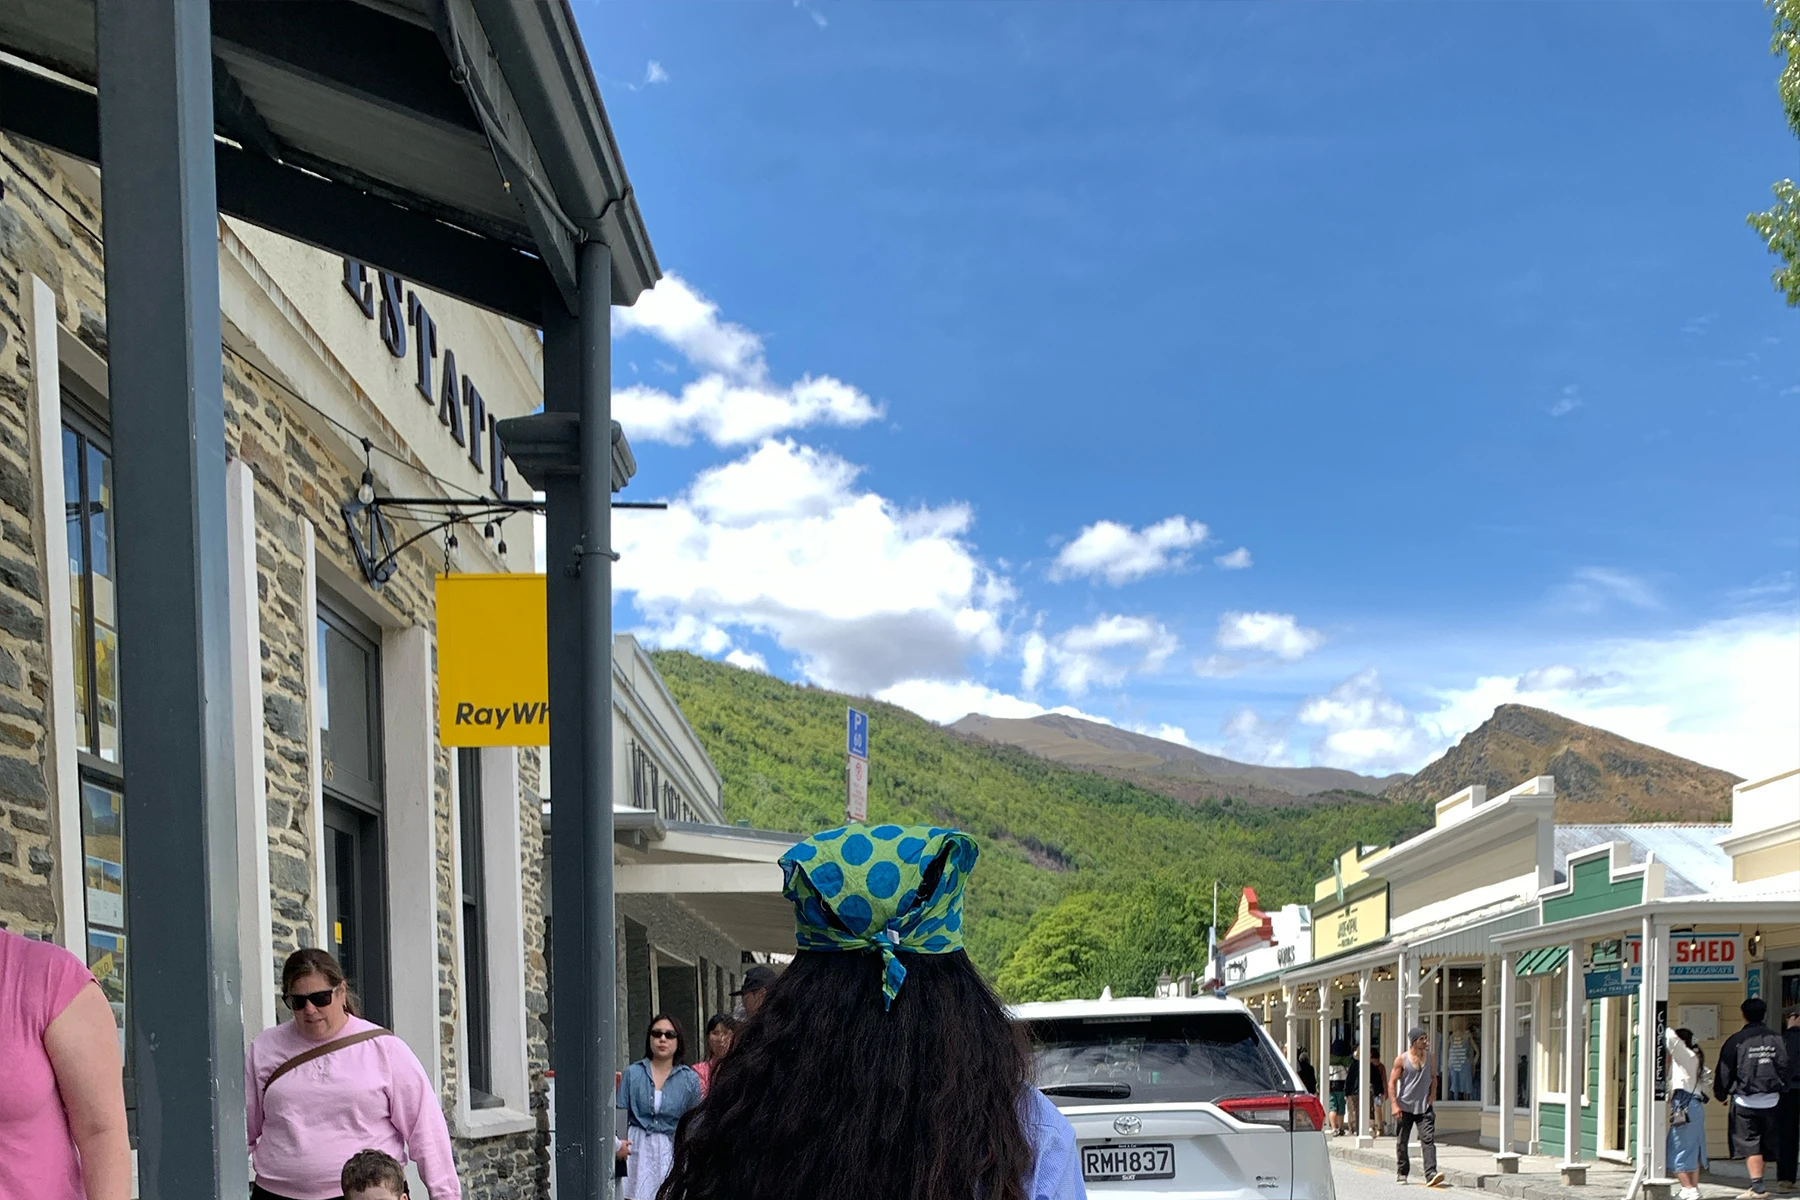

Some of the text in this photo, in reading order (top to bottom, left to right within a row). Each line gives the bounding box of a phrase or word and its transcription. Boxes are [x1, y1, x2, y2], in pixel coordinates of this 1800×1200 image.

[455, 702, 549, 730] RayWh
[854, 713, 862, 730] P
[1676, 941, 1735, 963] SHED
[1686, 965, 1733, 975] TAKEAWAYS
[1656, 1011, 1665, 1080] COFFEE
[1087, 1151, 1169, 1174] RMH837
